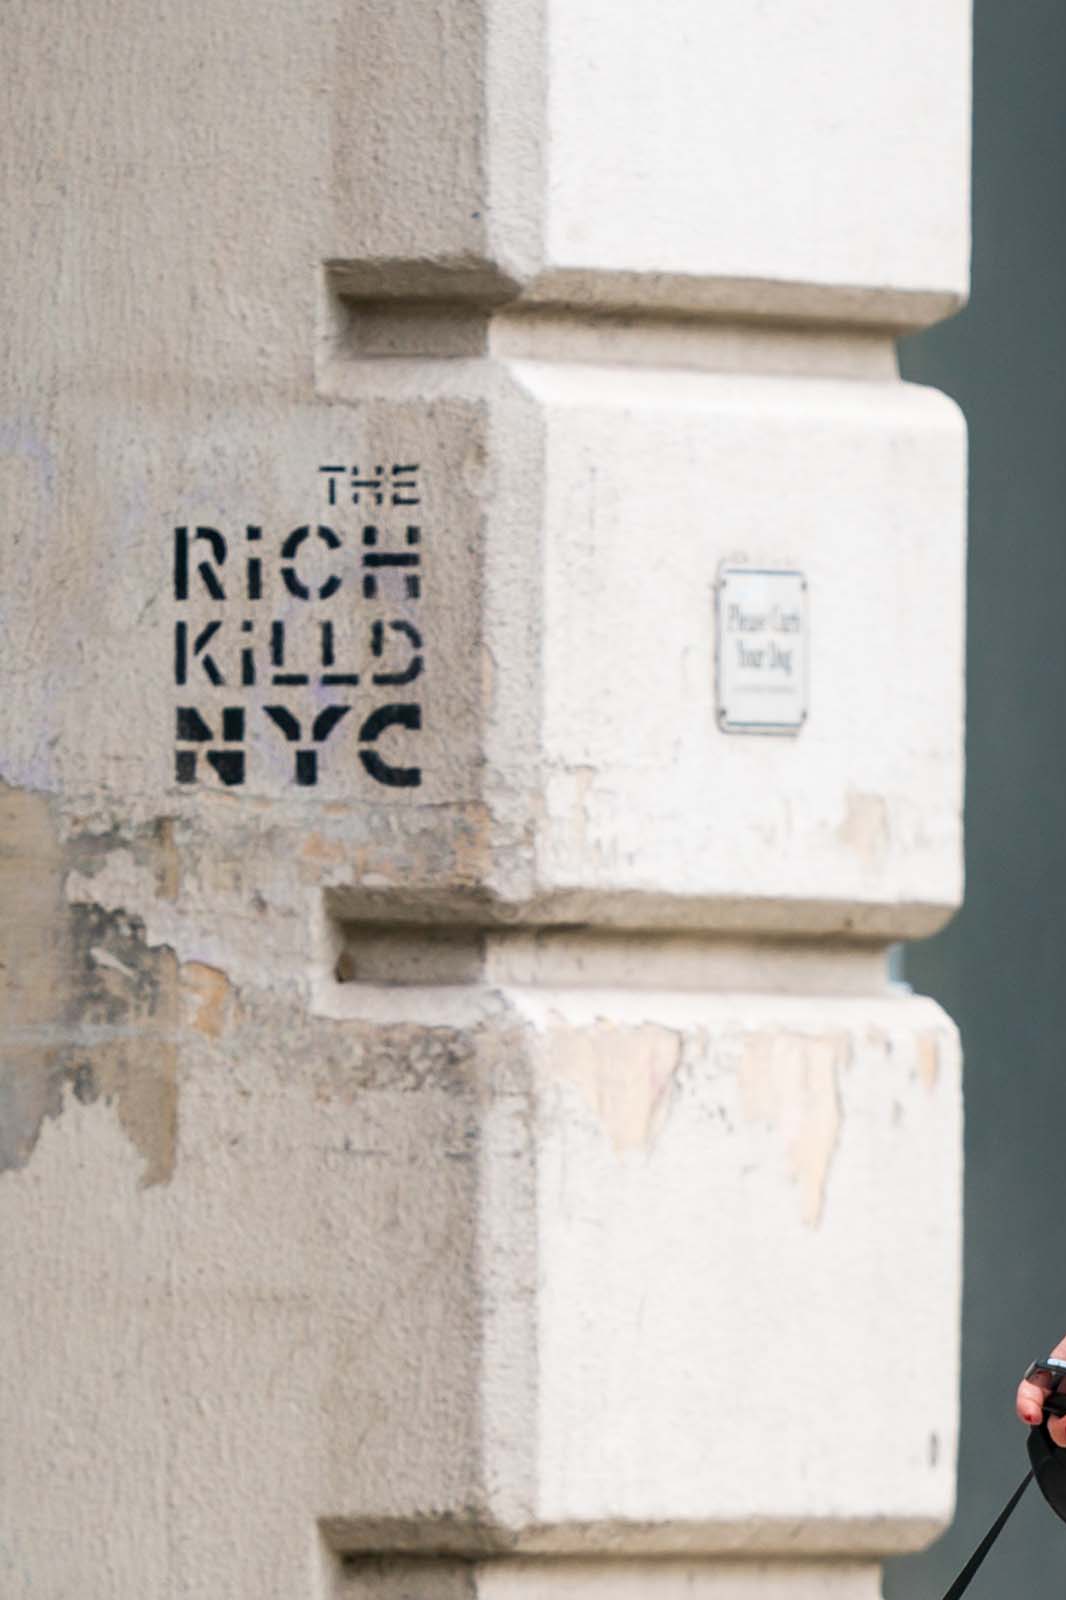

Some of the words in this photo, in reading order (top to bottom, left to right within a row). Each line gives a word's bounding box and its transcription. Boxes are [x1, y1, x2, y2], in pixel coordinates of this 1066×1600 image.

[319, 464, 420, 505] THE
[736, 639, 765, 669] Your
[768, 639, 793, 677] Dog
[174, 704, 422, 786] NYC
